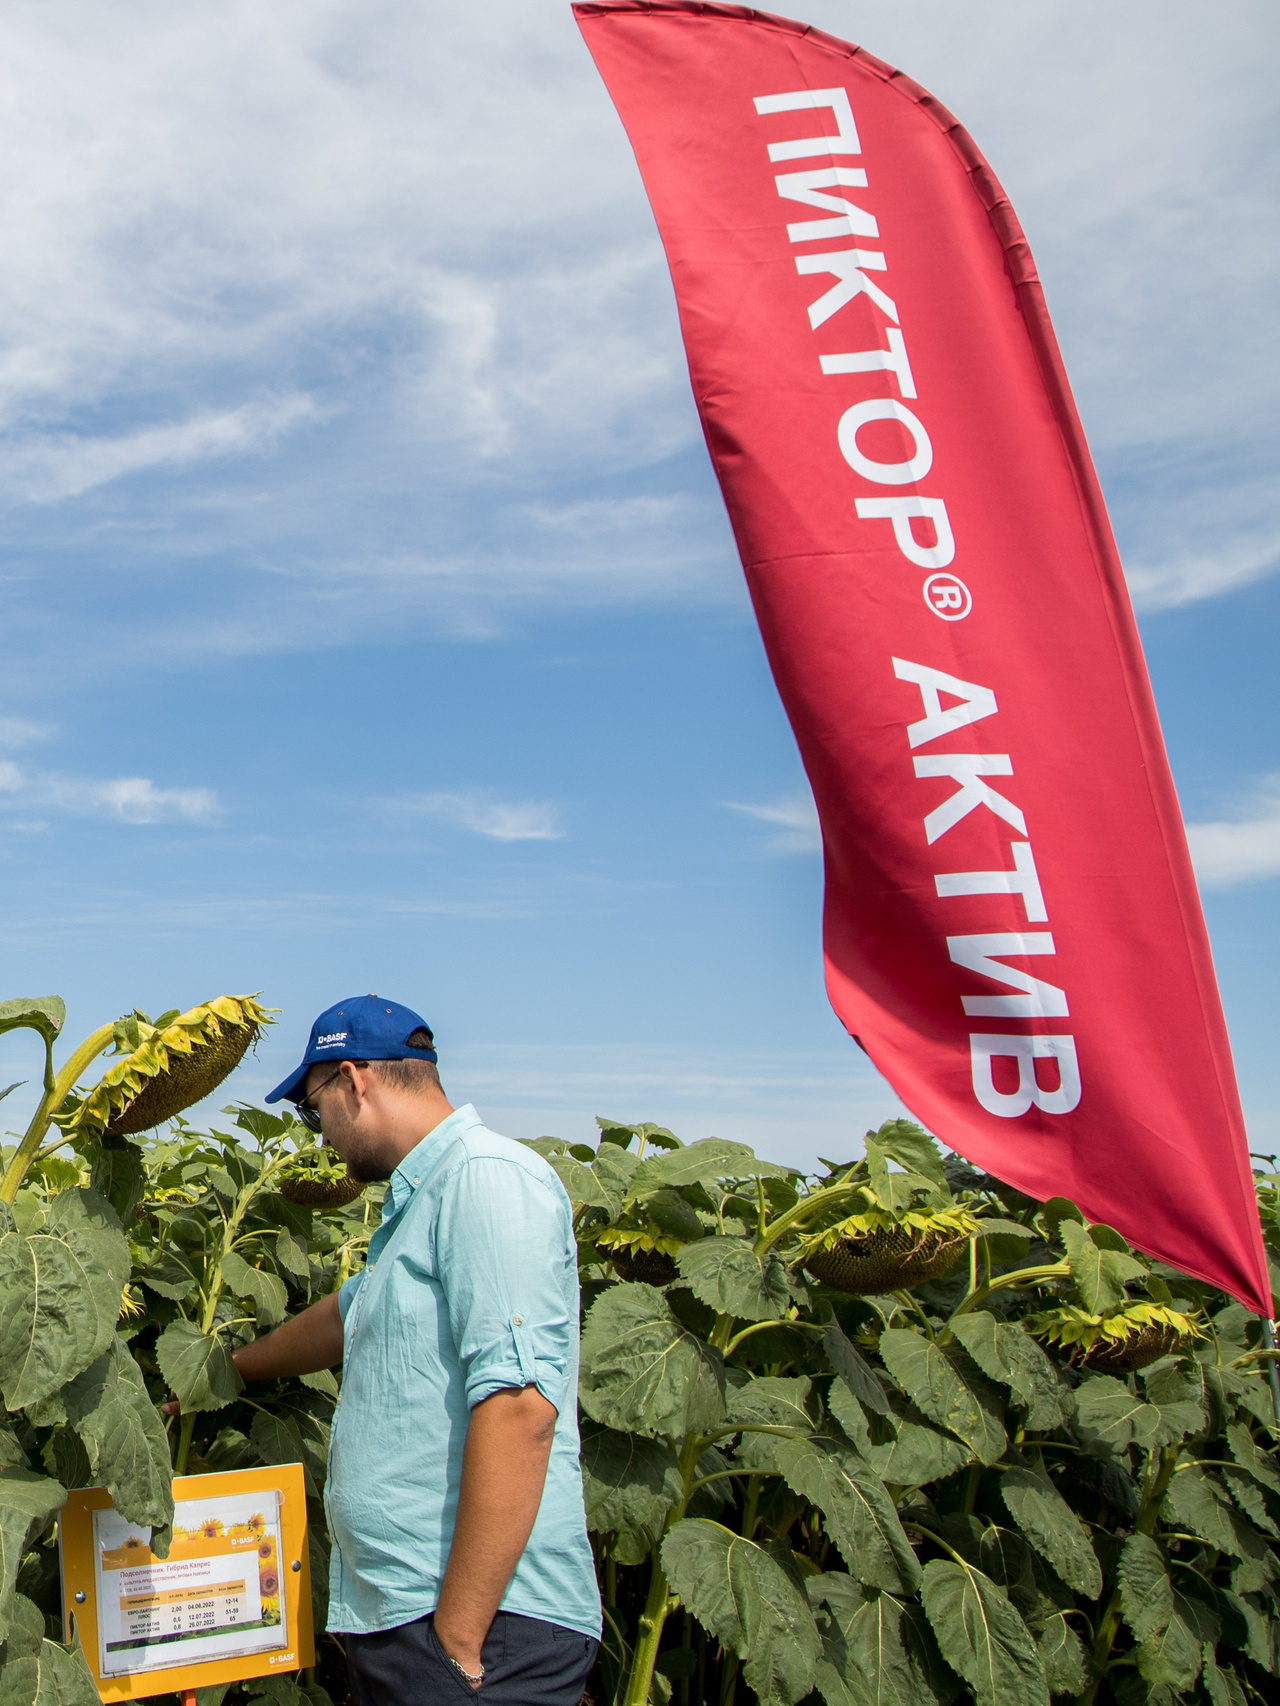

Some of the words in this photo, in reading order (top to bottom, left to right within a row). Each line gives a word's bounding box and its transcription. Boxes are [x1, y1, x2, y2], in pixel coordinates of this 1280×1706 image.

[892, 656, 1083, 1118] АКТИВ
[326, 1032, 348, 1043] BASF
[167, 1564, 188, 1573] Гибрид
[190, 1561, 211, 1570] Каприс
[188, 1602, 214, 1610] 04.06.2022
[189, 1612, 214, 1620] 12.07.2022
[189, 1619, 215, 1628] 26.07.2022
[278, 1653, 295, 1662] BASF
